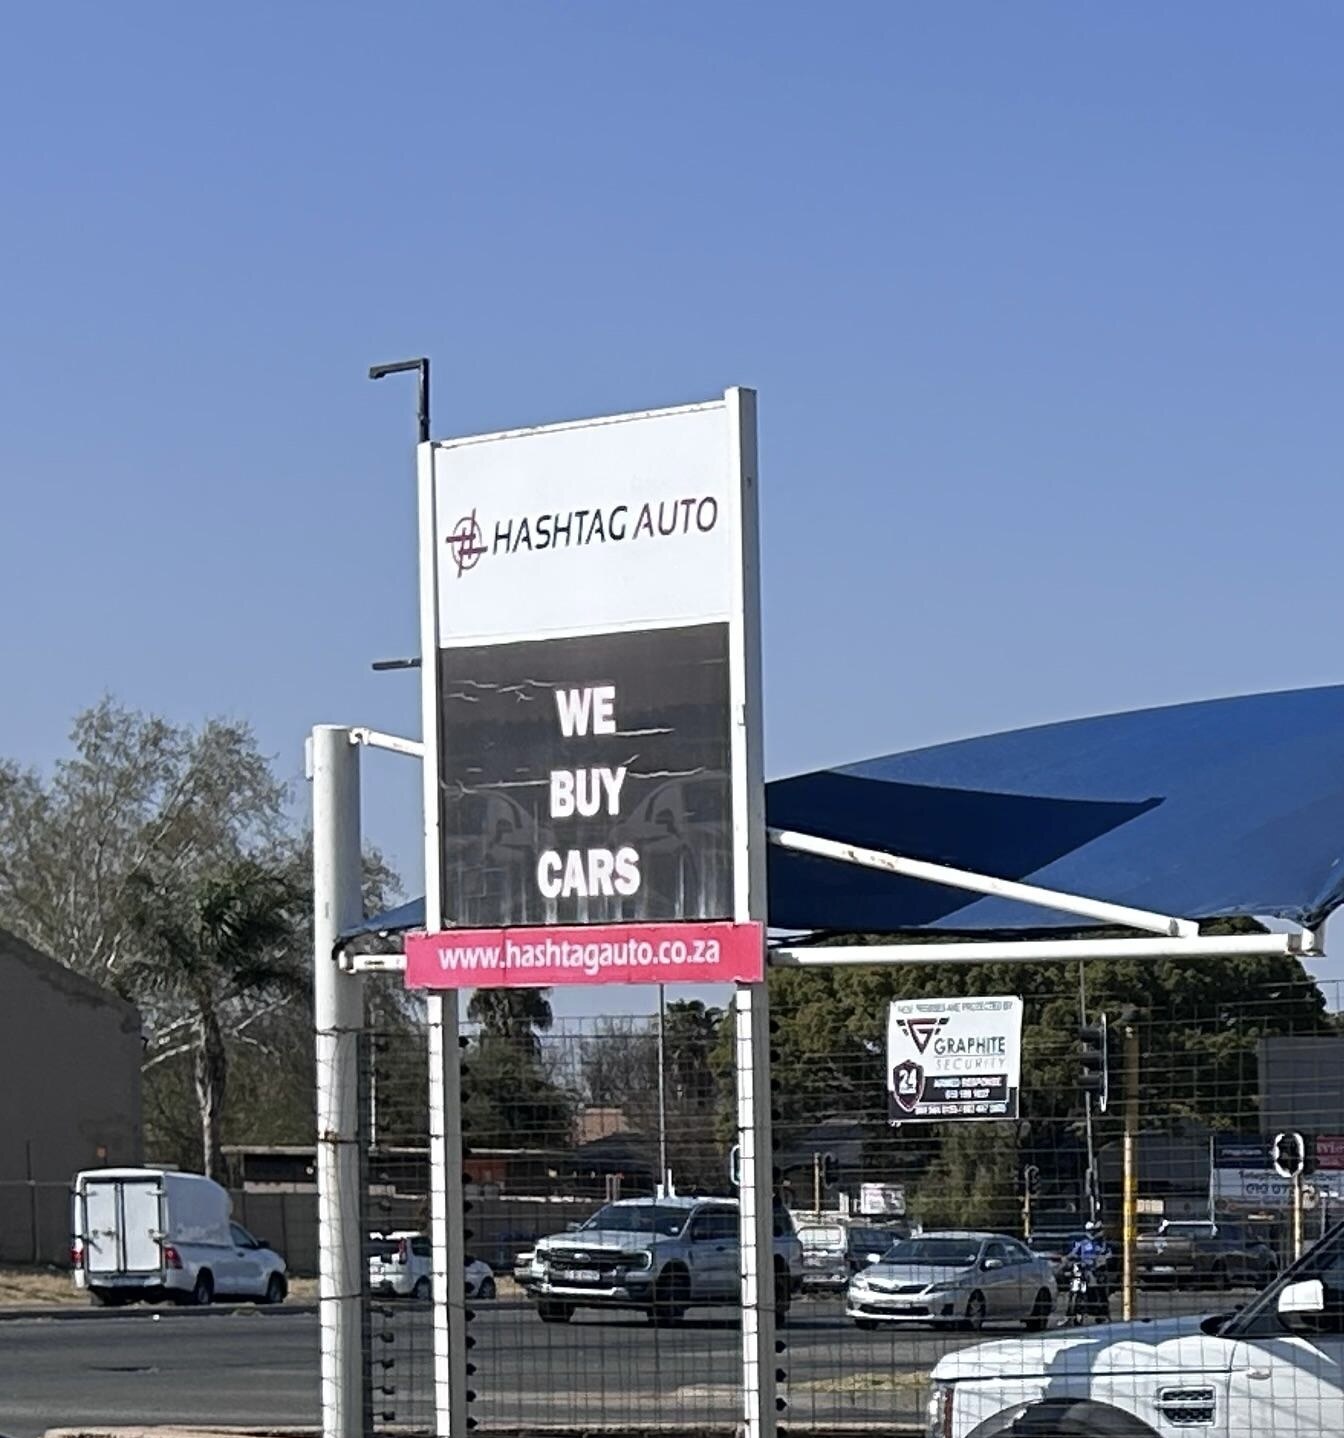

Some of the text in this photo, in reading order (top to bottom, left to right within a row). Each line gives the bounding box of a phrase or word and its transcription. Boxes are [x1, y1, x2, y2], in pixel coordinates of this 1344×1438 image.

[492, 496, 718, 555] HASHTAG AUTO
[555, 685, 616, 737] WE
[549, 766, 627, 819] BUY
[537, 847, 641, 899] CARS
[438, 937, 720, 975] www.hashtagauto.co.za
[933, 1036, 1006, 1055] GRAPHITE
[935, 1057, 1007, 1071] SECURITY
